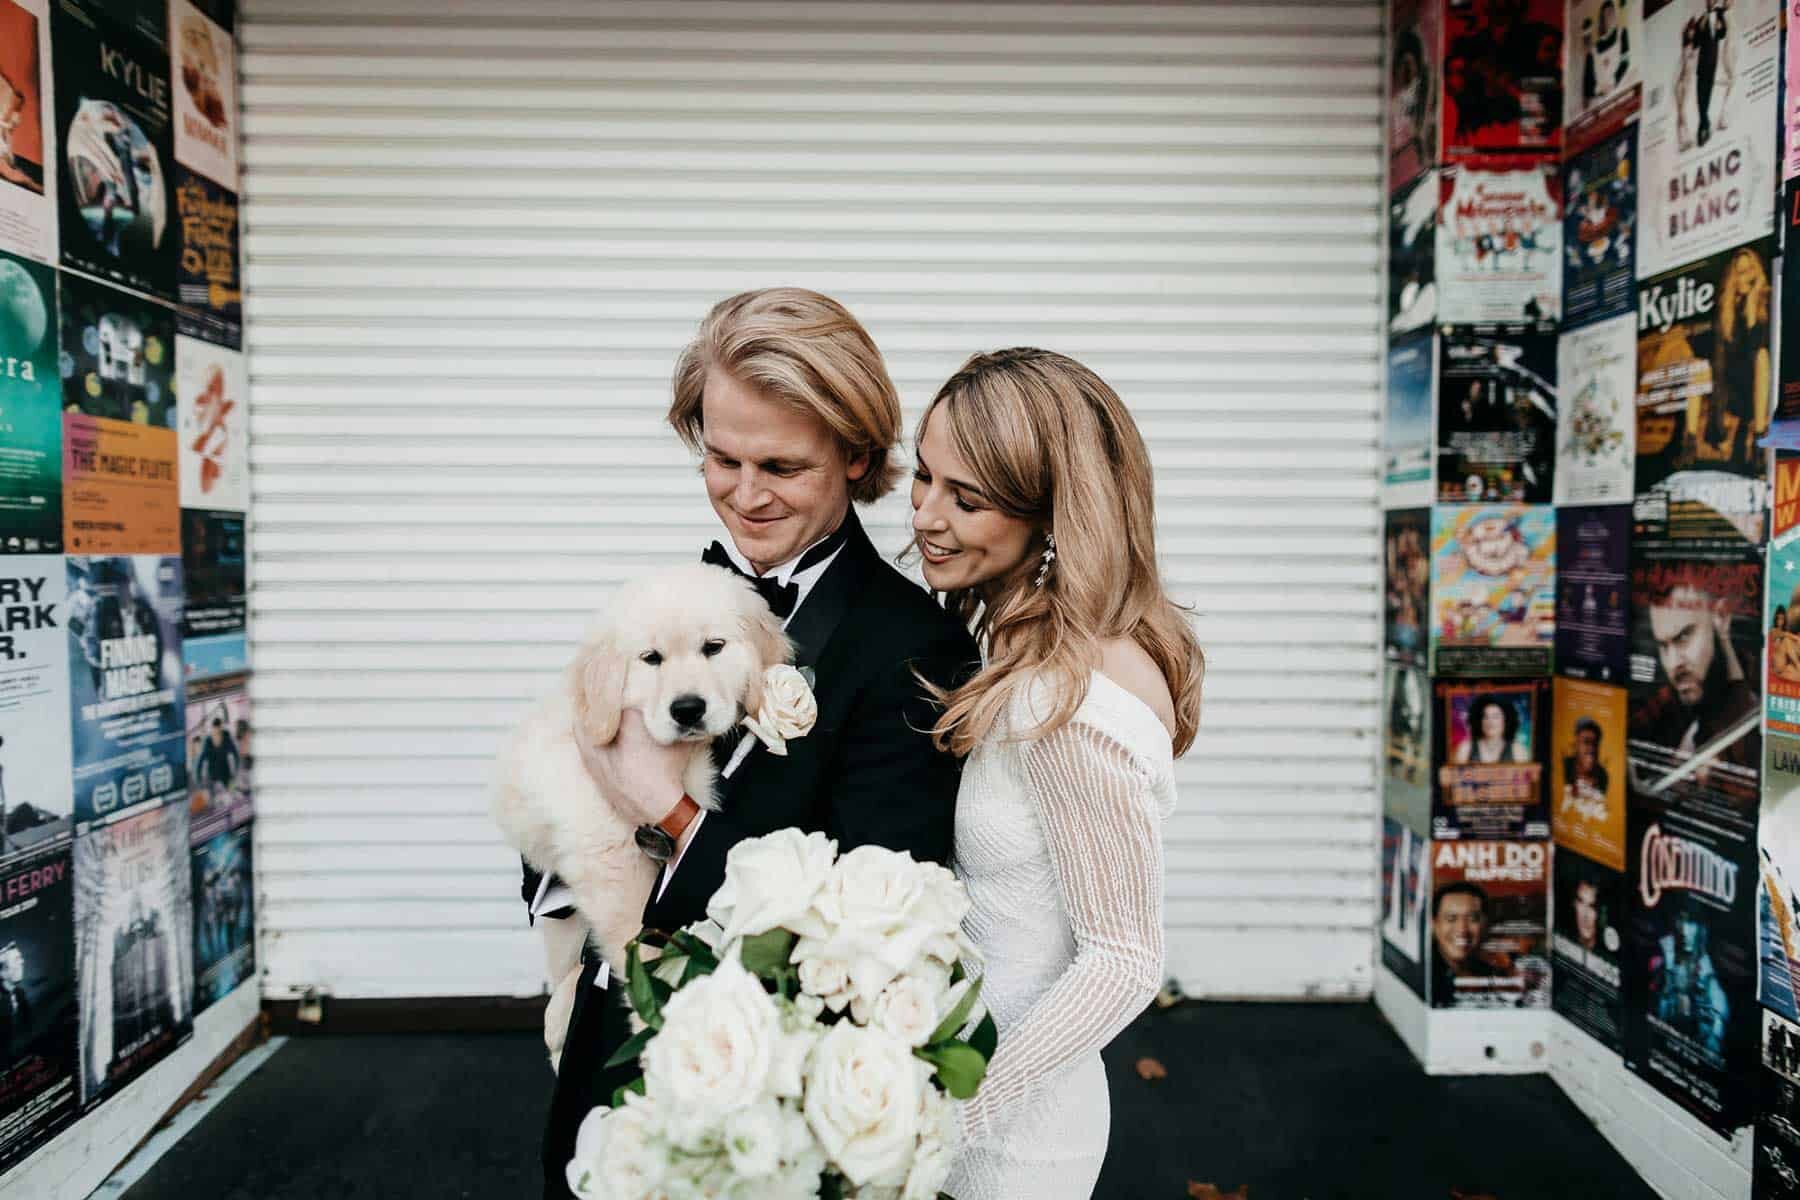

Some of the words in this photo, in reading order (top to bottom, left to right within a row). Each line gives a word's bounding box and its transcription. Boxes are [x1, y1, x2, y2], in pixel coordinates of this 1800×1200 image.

[100, 42, 168, 110] KYLIE
[1669, 149, 1741, 203] BLANC
[1669, 188, 1740, 238] BLANC
[1639, 277, 1715, 333] Kylie
[0, 357, 35, 381] ra
[100, 455, 137, 477] MAGIC
[0, 604, 57, 632] RK
[101, 633, 157, 670] FINDING
[106, 664, 156, 700] MAGIC
[1435, 842, 1497, 869] ANH
[1504, 842, 1545, 868] DO
[7, 860, 66, 904] FERRY
